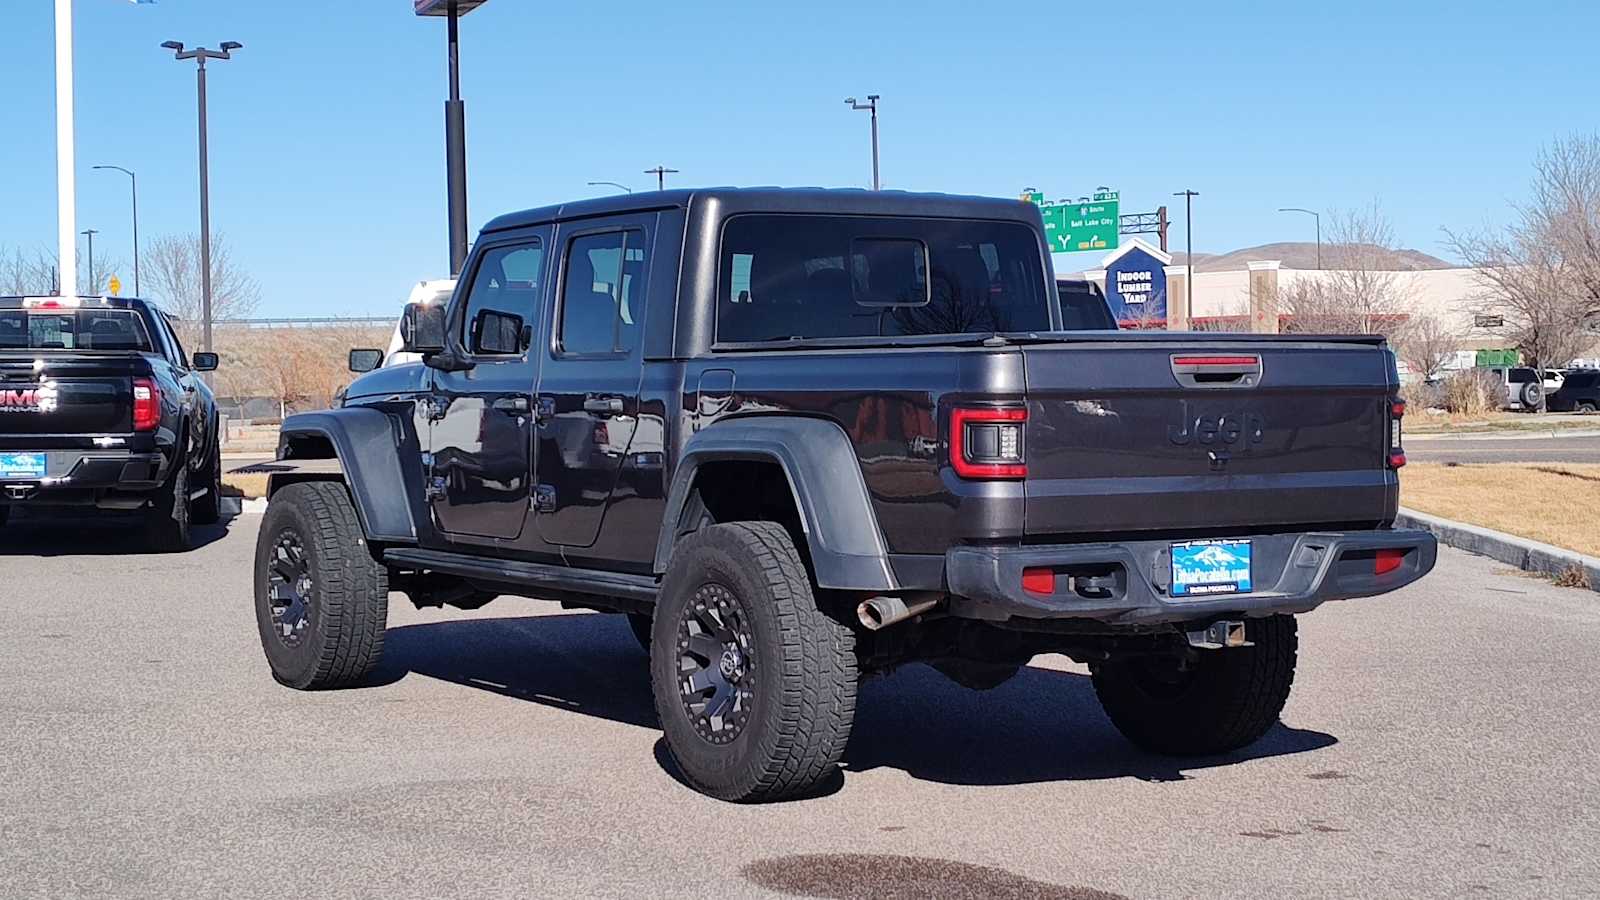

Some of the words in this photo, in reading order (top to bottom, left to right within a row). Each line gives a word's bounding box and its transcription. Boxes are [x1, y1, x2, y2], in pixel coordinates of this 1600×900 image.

[1071, 220, 1083, 228] Salt
[1101, 217, 1113, 225] City
[1117, 271, 1152, 280] INDOOR
[1117, 282, 1152, 292] LUMBER
[1124, 293, 1148, 304] YARD
[1169, 398, 1264, 451] Jeep
